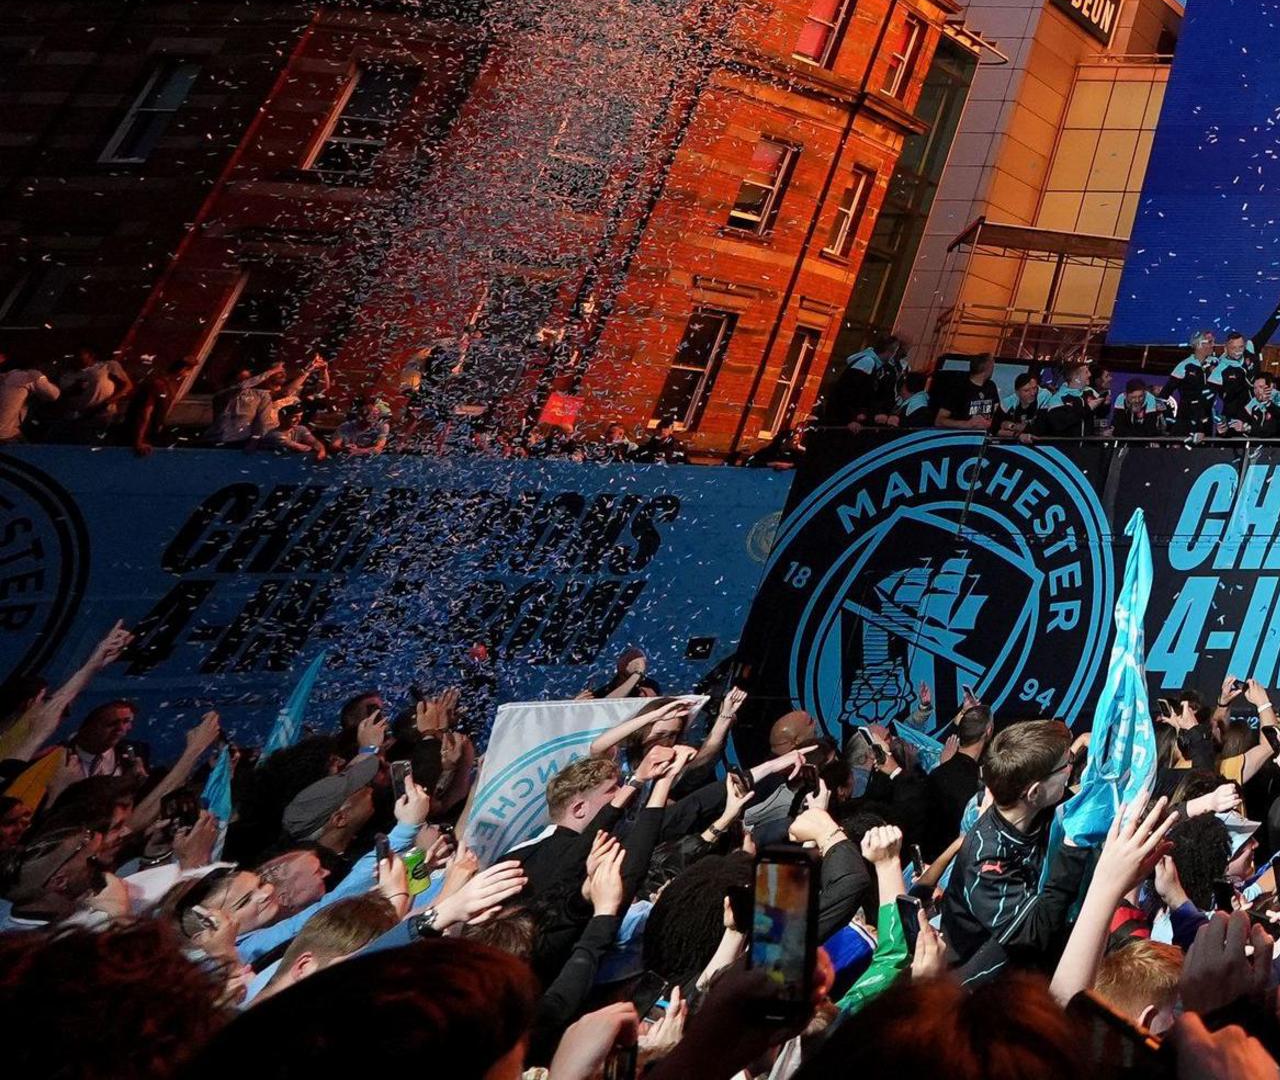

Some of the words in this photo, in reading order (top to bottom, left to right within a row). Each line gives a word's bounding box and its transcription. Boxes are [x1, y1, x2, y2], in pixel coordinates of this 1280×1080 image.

[160, 482, 681, 577] CHAIONS
[836, 456, 1081, 634] MANCHESTER
[782, 560, 812, 589] 18
[1018, 678, 1057, 717] 94
